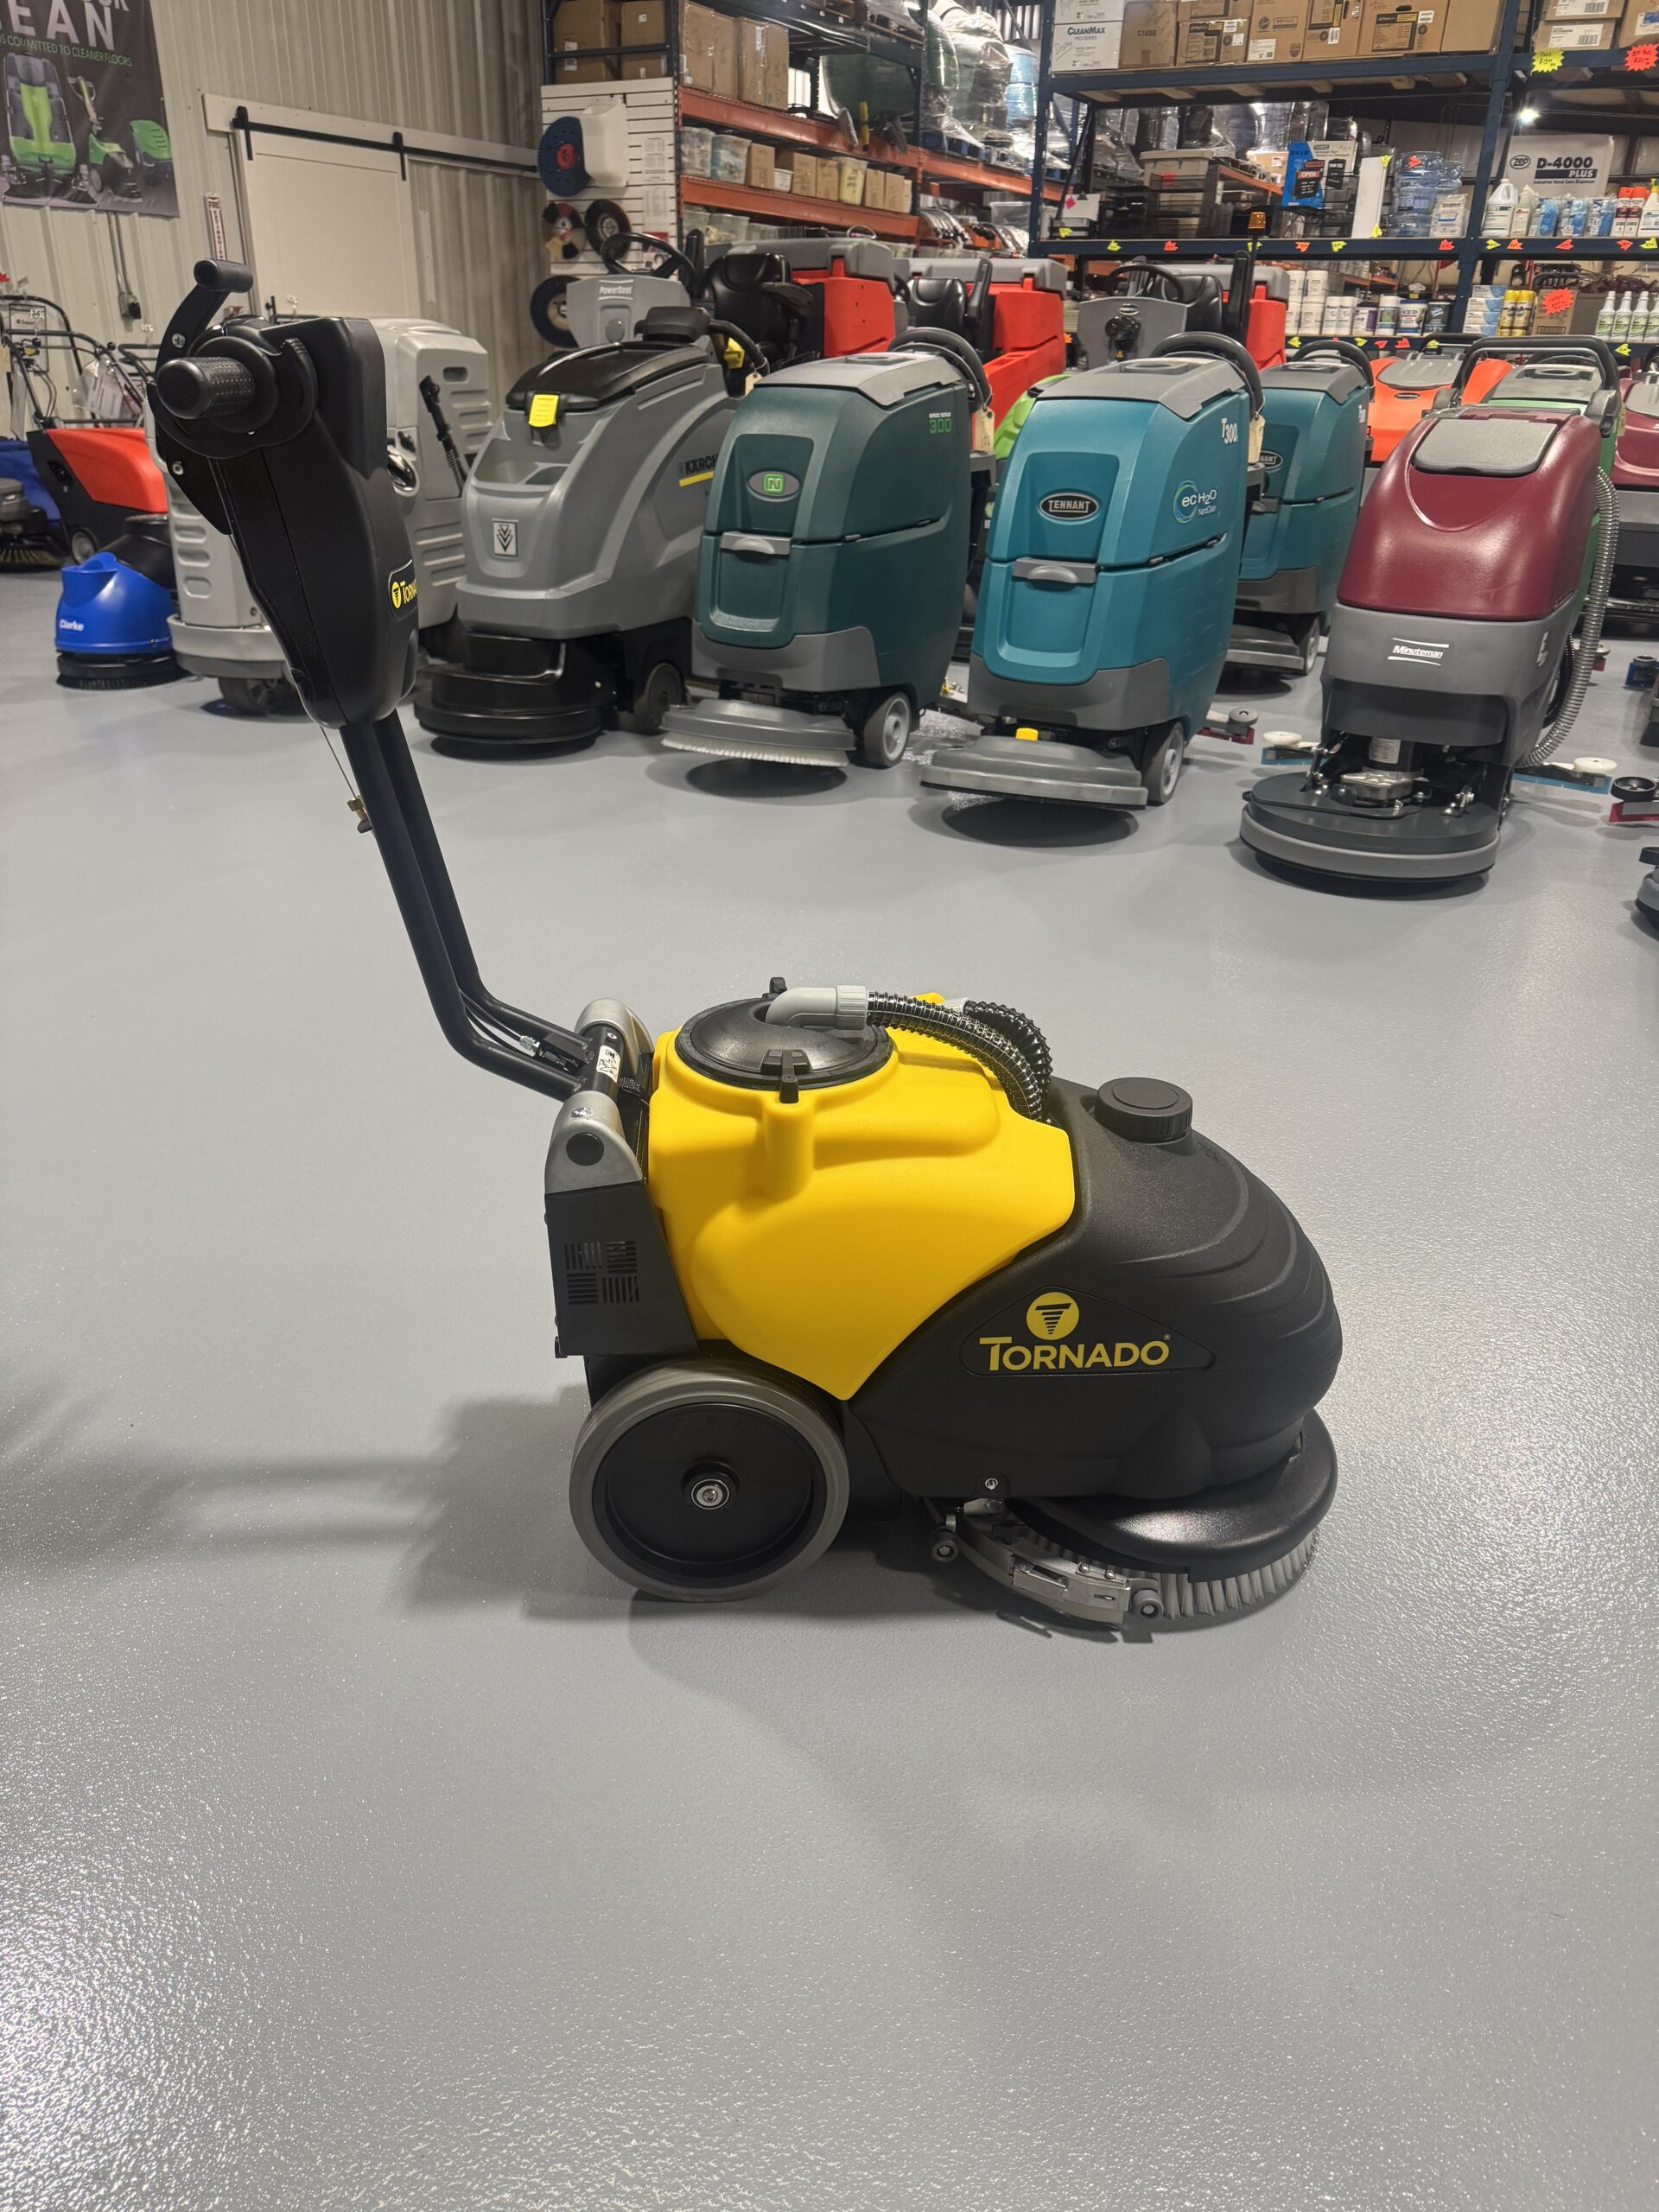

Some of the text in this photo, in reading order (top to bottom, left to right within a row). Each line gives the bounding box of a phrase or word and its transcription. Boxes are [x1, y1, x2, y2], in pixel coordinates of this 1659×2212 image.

[0, 0, 114, 50] EAN
[58, 44, 71, 55] TO
[1536, 156, 1593, 168] D-4000
[1568, 169, 1594, 178] PLUS
[930, 418, 952, 434] 300
[1048, 500, 1090, 513] TENNANT
[60, 619, 85, 632] Clarke
[1392, 645, 1444, 659] Minuteman
[979, 1336, 1171, 1371] TORNADO
